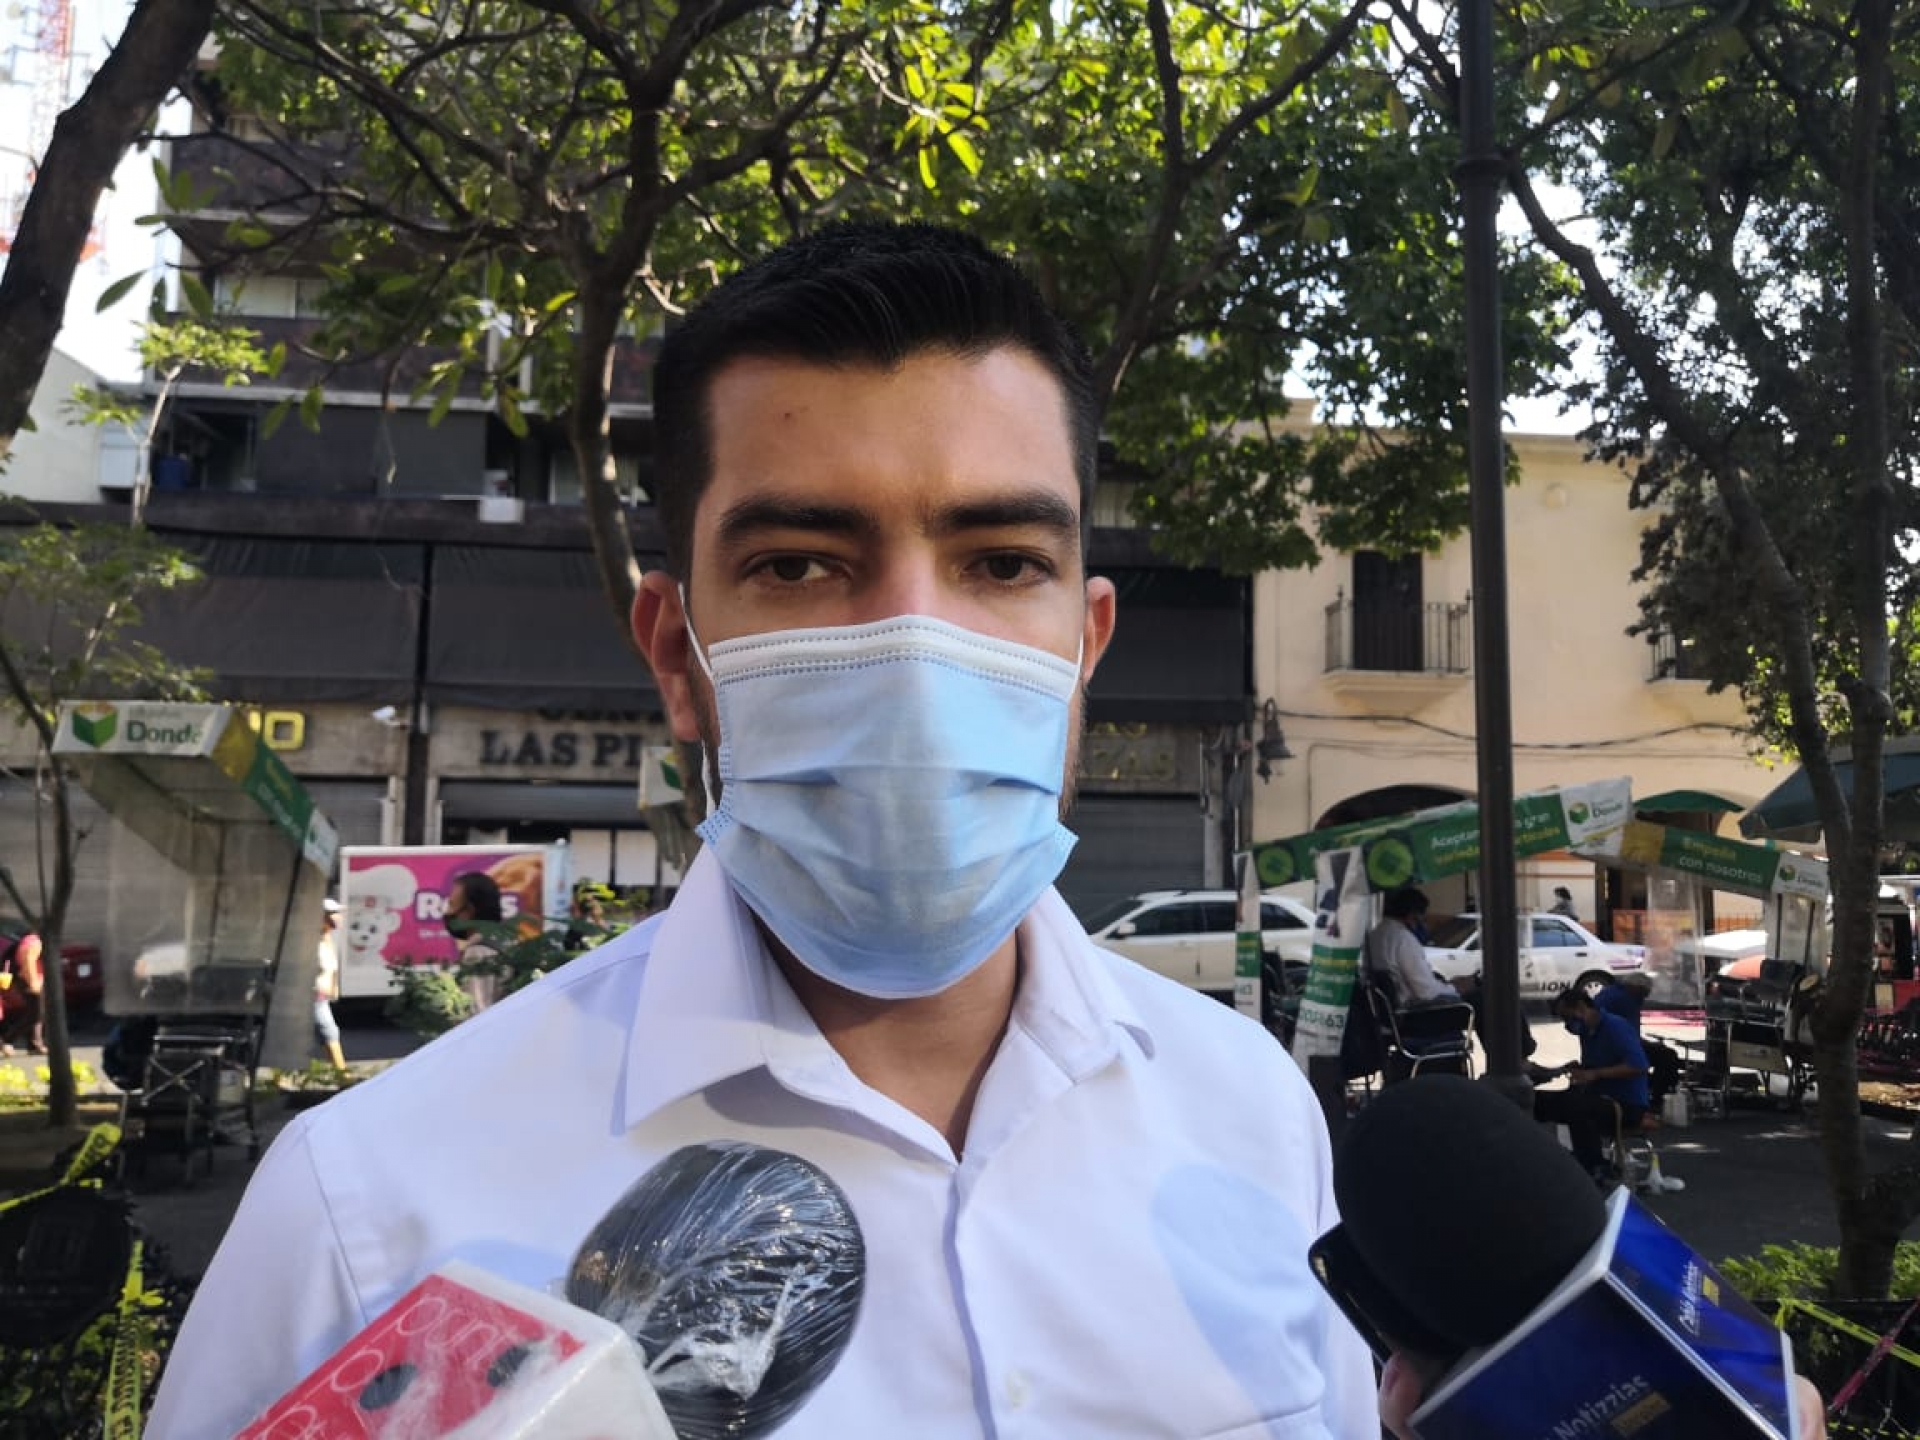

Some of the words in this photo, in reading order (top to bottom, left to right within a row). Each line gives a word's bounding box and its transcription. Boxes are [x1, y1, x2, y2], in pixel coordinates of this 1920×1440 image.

[479, 730, 578, 767] LAS
[1679, 854, 1703, 870] con
[1706, 862, 1763, 883] nosotros
